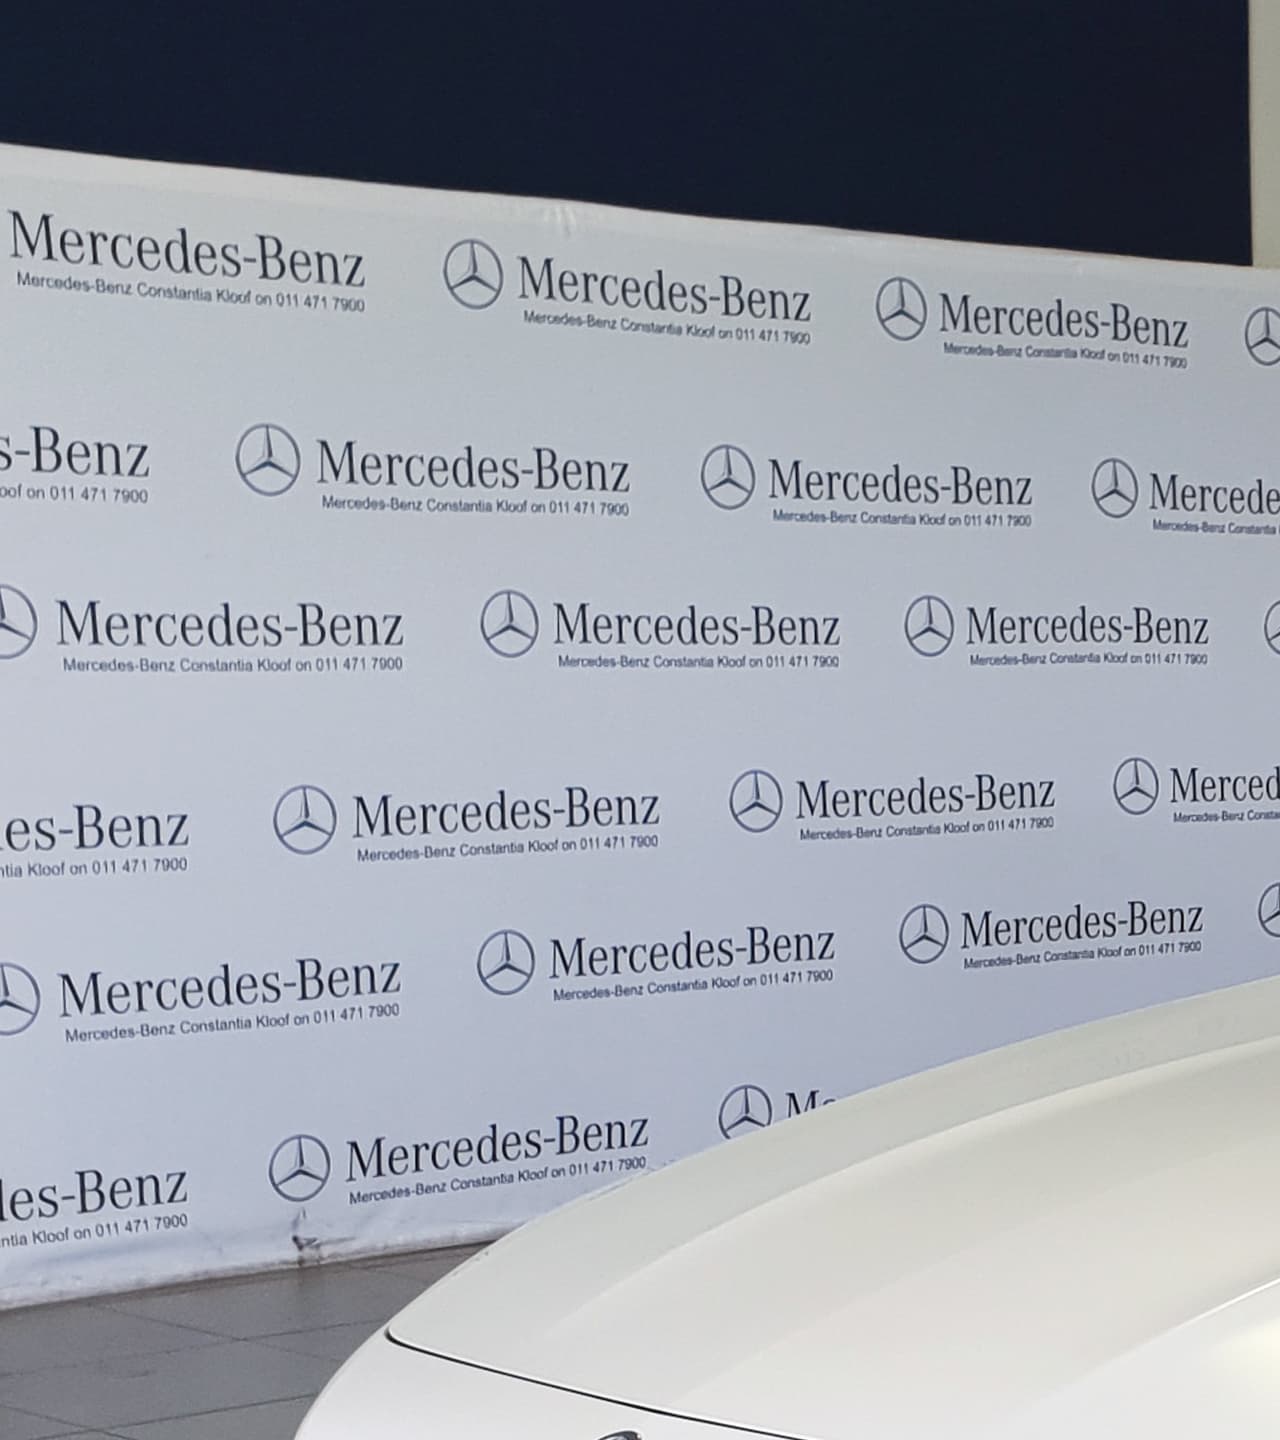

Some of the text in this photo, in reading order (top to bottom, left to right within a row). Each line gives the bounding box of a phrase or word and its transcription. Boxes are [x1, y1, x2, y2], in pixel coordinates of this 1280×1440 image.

[8, 210, 365, 287] Mercedes-Benz
[16, 270, 366, 312] Mercedes-Benz Constantia Kloof on 011 471 7900
[517, 256, 811, 322] Mercedes-Benz
[522, 310, 811, 345] Mercedes-Benz Constantia Kloof on 011 471 7900
[939, 293, 1188, 348] Mercedes-Benz
[316, 440, 630, 492] Mercedes-Benz
[768, 459, 1032, 505] Mercedes-Benz
[26, 486, 148, 504] on 011 471 7900
[321, 494, 629, 516] Mercedes-Benz Constantia Kloof on 011 471 7900
[772, 509, 858, 524] Mercedes-Benz
[919, 513, 947, 525] Kloof
[948, 517, 962, 526] on
[963, 514, 982, 527] 011
[984, 514, 1003, 526] 471
[1006, 514, 1032, 527] 7900
[55, 600, 403, 647] Mercedes-Benz
[553, 603, 840, 646] Mercedes-Benz
[966, 605, 1209, 645] Mercedes-Benz
[62, 656, 403, 672] Mercedes-Benz Constantia Kloof on 011 471 7900
[557, 654, 839, 668] Mercedes-Benz Constantia Kloof on 011 471 7900
[969, 653, 1047, 666] Mercedes-Benz
[1103, 652, 1128, 663] Kloof
[1129, 655, 1143, 664] on
[1144, 653, 1162, 664] 011
[1163, 653, 1182, 664] 471
[1184, 653, 1208, 665] 7900
[352, 787, 660, 838] Mercedes-Benz
[796, 774, 1055, 819] Mercedes-Benz
[0, 804, 189, 852] es-Benz
[356, 835, 659, 862] Mercedes-Benz Constantia Kloof on 011 471 7900
[799, 827, 883, 840] Mercedes-Benz
[943, 820, 971, 834] Kloof
[971, 823, 986, 832] on
[987, 819, 1006, 832] 011
[1007, 818, 1027, 830] 471
[1029, 816, 1054, 829] 7900
[27, 861, 65, 877] Kloof
[68, 864, 88, 875] on
[91, 860, 116, 875] 011
[121, 859, 147, 872] 471
[153, 857, 188, 872] 7900
[960, 901, 1203, 949] Mercedes-Benz
[549, 926, 835, 979] Mercedes-Benz
[963, 953, 1041, 969] Mercedes-Benz
[1097, 945, 1122, 958] Kloof
[1123, 947, 1137, 957] on
[1138, 944, 1155, 956] 011
[1157, 943, 1175, 954] 471
[1178, 940, 1202, 953] 7900
[57, 958, 401, 1018] Mercedes-Benz
[552, 968, 834, 1001] Mercedes-Benz Constantia Kloof on 011 471 7900
[64, 1003, 400, 1042] Mercedes-Benz Constantia Kloof on 011 471 7900
[345, 1115, 648, 1183] Mercedes-Benz
[0, 1170, 187, 1222] es-Benz
[348, 1156, 647, 1205] Mercedes-Benz Constantia Kloof on 011 471 7900
[31, 1227, 70, 1245] Kloof
[72, 1228, 92, 1240] on
[95, 1221, 119, 1237] 011
[124, 1218, 149, 1232] 471
[153, 1213, 188, 1230] 7900
